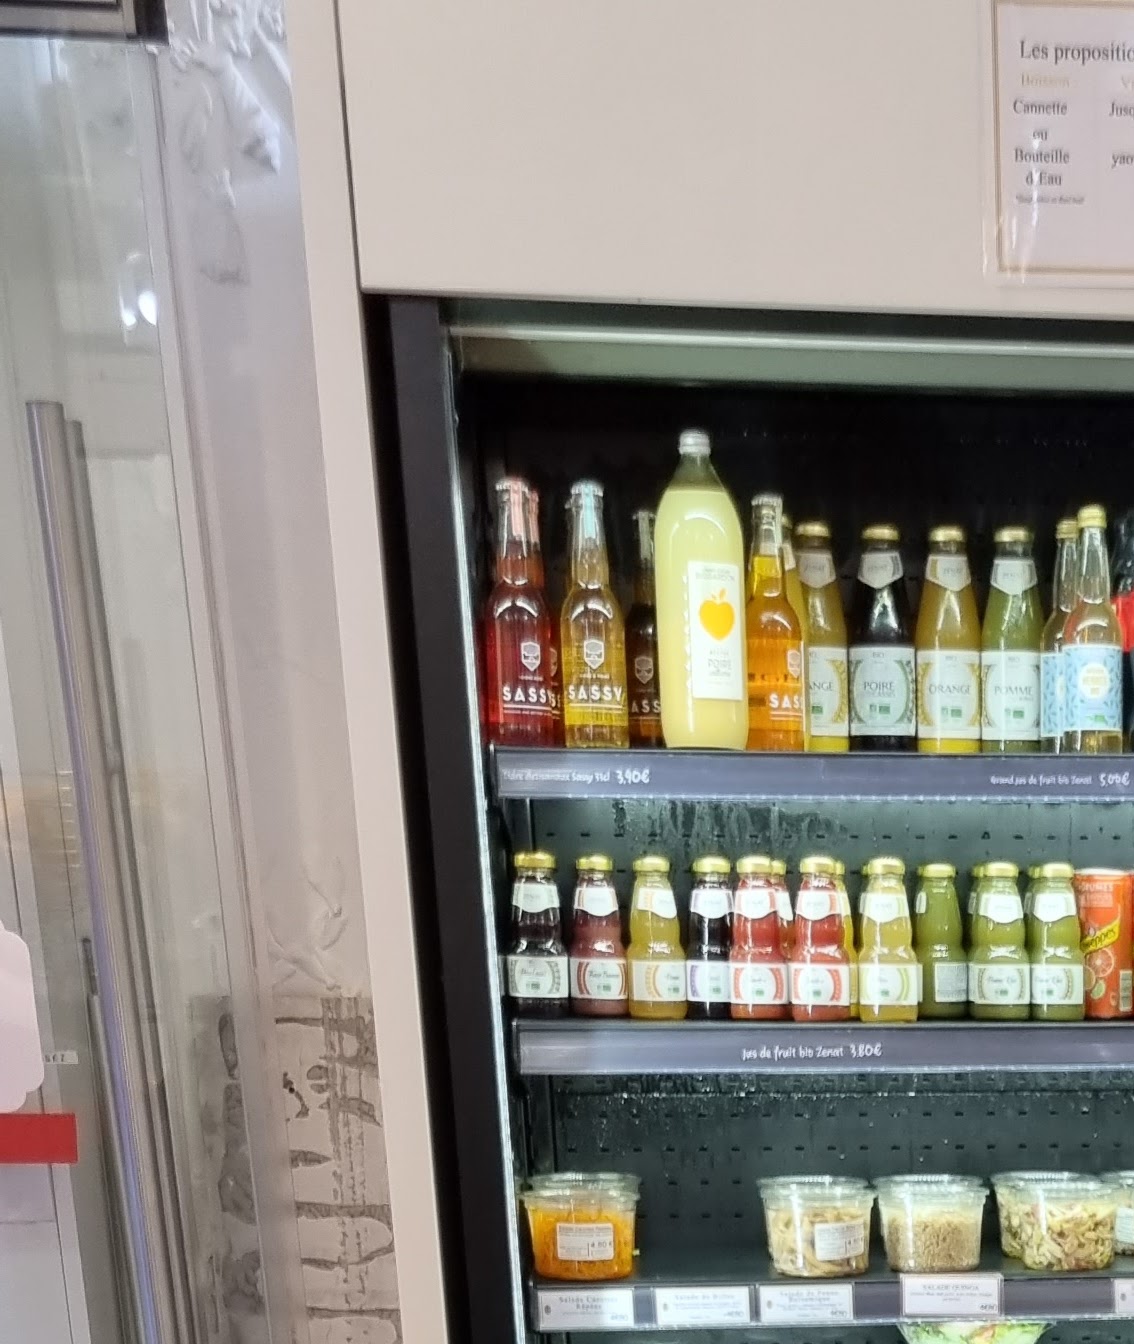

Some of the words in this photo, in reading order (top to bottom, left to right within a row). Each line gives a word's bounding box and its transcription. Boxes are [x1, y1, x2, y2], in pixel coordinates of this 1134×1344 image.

[1020, 40, 1049, 62] Les
[1013, 99, 1068, 117] Cannette
[1014, 147, 1070, 165] Bouteille
[1025, 171, 1062, 187] dEau
[568, 684, 623, 702] SASSY
[863, 680, 895, 692] POIRE
[928, 684, 971, 695] ORANGE
[994, 685, 1033, 696] POMME
[615, 768, 650, 785] 3,90€
[1099, 771, 1131, 787] 5,00€
[774, 1045, 796, 1061] fruit
